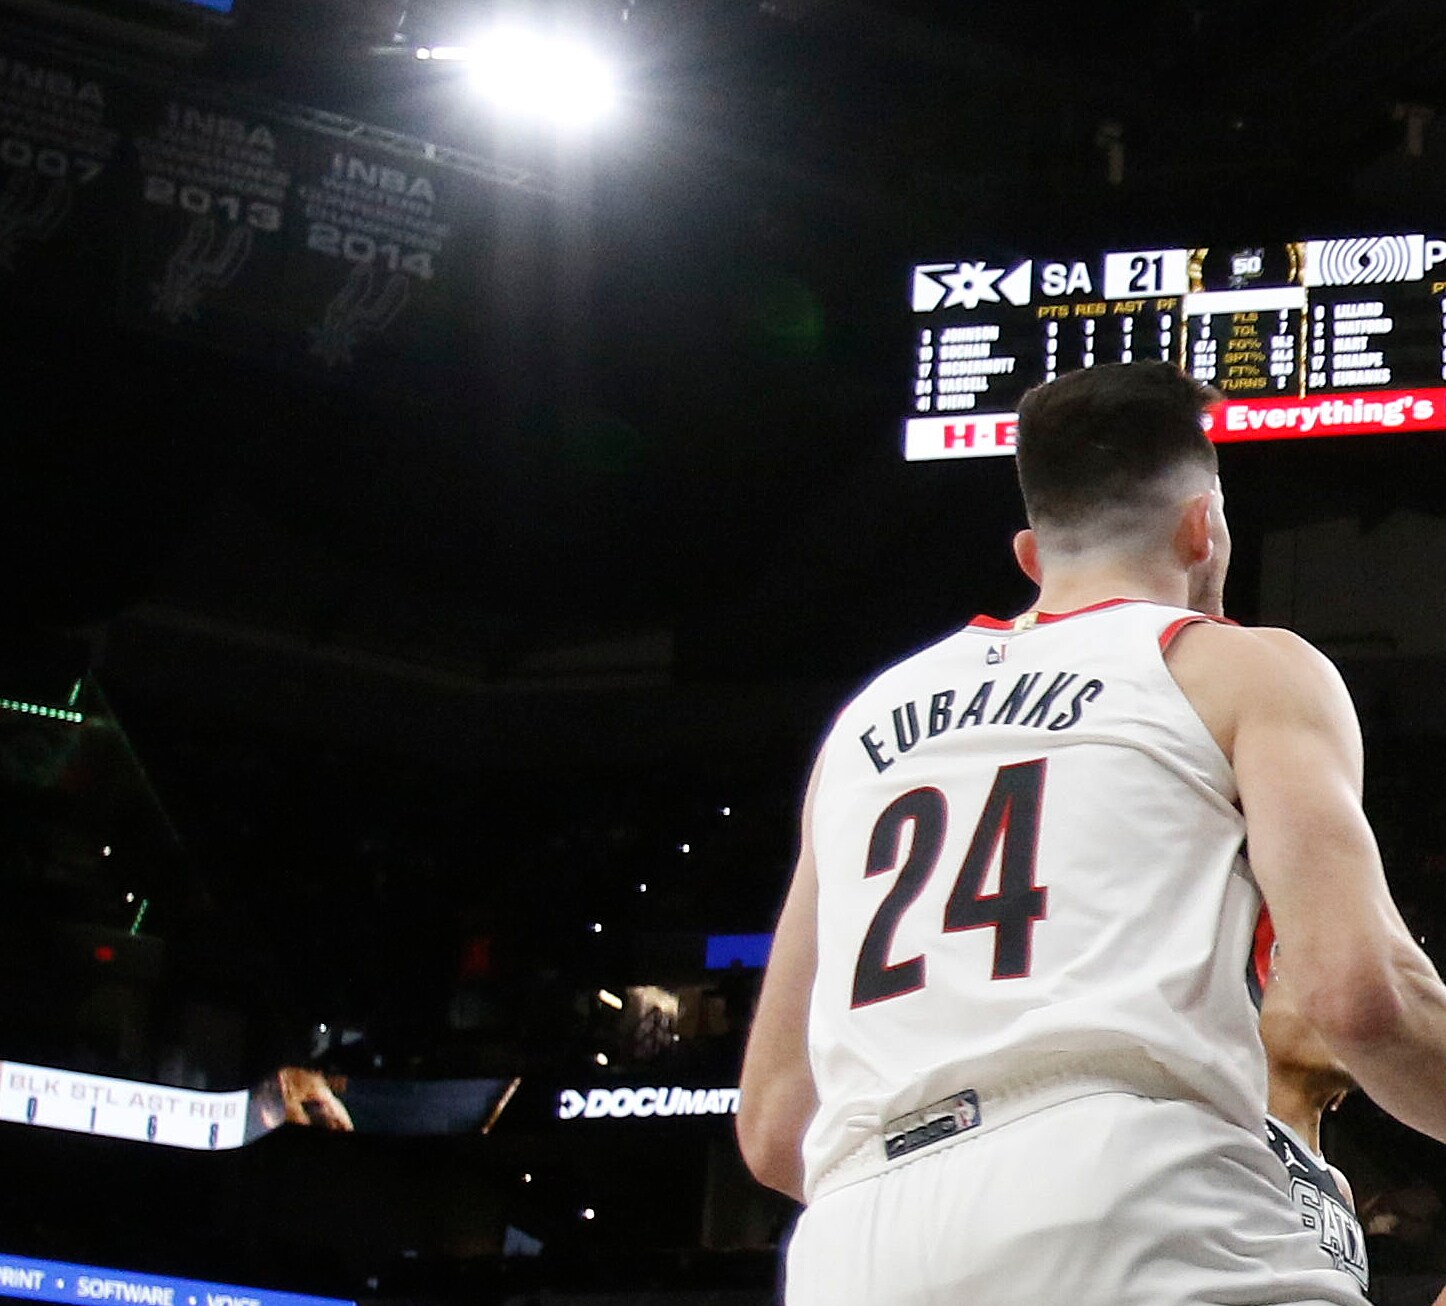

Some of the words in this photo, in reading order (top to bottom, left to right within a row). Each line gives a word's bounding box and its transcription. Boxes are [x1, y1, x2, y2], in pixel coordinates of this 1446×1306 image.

[0, 138, 100, 182] 007
[144, 176, 282, 233] 2013
[307, 222, 435, 280] 2014
[1041, 262, 1092, 296] SA
[1129, 256, 1164, 292] 21
[1037, 305, 1070, 319] PTS
[1075, 303, 1107, 317] REB
[1114, 300, 1147, 314] AST
[1157, 298, 1178, 312] PF
[1333, 301, 1384, 320] LILLARD
[941, 326, 999, 343] JOHNSON
[1333, 318, 1393, 337] WATFORD
[1332, 336, 1369, 354] HART
[1333, 352, 1384, 370] SHARPE
[1220, 377, 1268, 391] TURNS
[1332, 368, 1391, 388] EUBANKS
[943, 421, 1018, 449] H-E
[1226, 392, 1435, 433] Everything's
[859, 672, 1104, 774] EUBANKS
[850, 757, 1048, 1011] 24
[10, 1073, 60, 1097] BLK
[70, 1083, 123, 1106] STL
[129, 1090, 181, 1114] AST
[189, 1101, 238, 1118] REB
[584, 1087, 742, 1118] DOCUMATI
[27, 1096, 38, 1124] 0
[90, 1106, 97, 1132] 1
